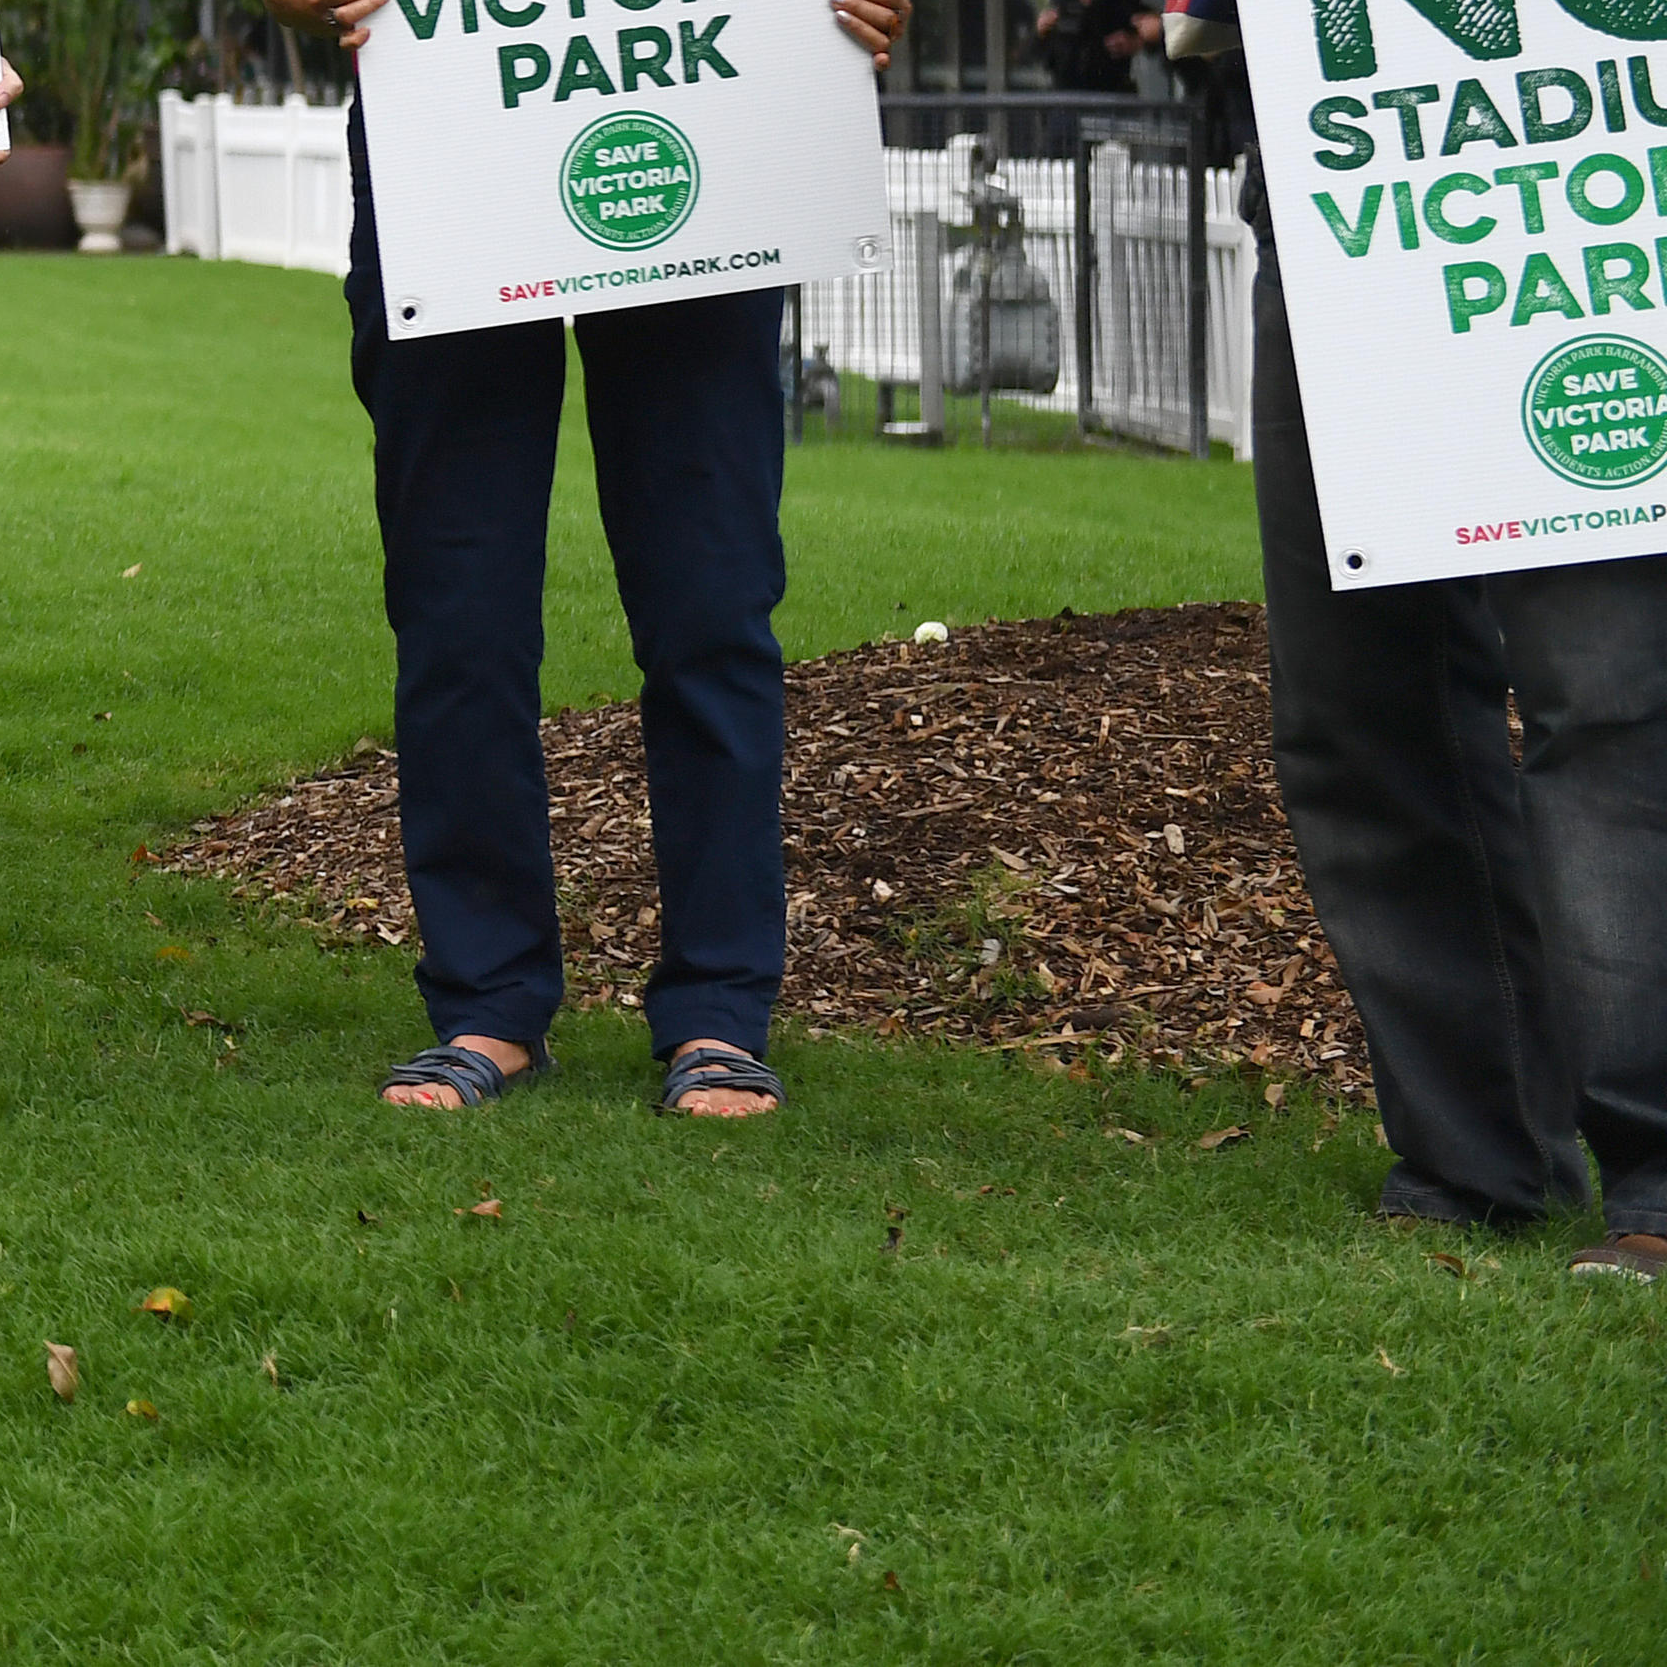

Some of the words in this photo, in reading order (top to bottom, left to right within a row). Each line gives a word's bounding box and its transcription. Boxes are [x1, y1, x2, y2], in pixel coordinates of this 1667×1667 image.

[497, 15, 739, 109] PARK
[595, 142, 660, 167] SAVE
[570, 165, 690, 197] VICTORIA
[599, 194, 666, 220] PARK
[499, 249, 781, 302] SAVEVICTORIAPARK.COM
[1443, 237, 1667, 334] PAR
[1535, 358, 1571, 405] VICTORIA
[1570, 346, 1603, 362] PARK
[1563, 368, 1638, 396] SAVE
[1541, 434, 1601, 477] RESIDENTS
[1605, 457, 1651, 478] ACTION
[1570, 426, 1649, 455] PARK
